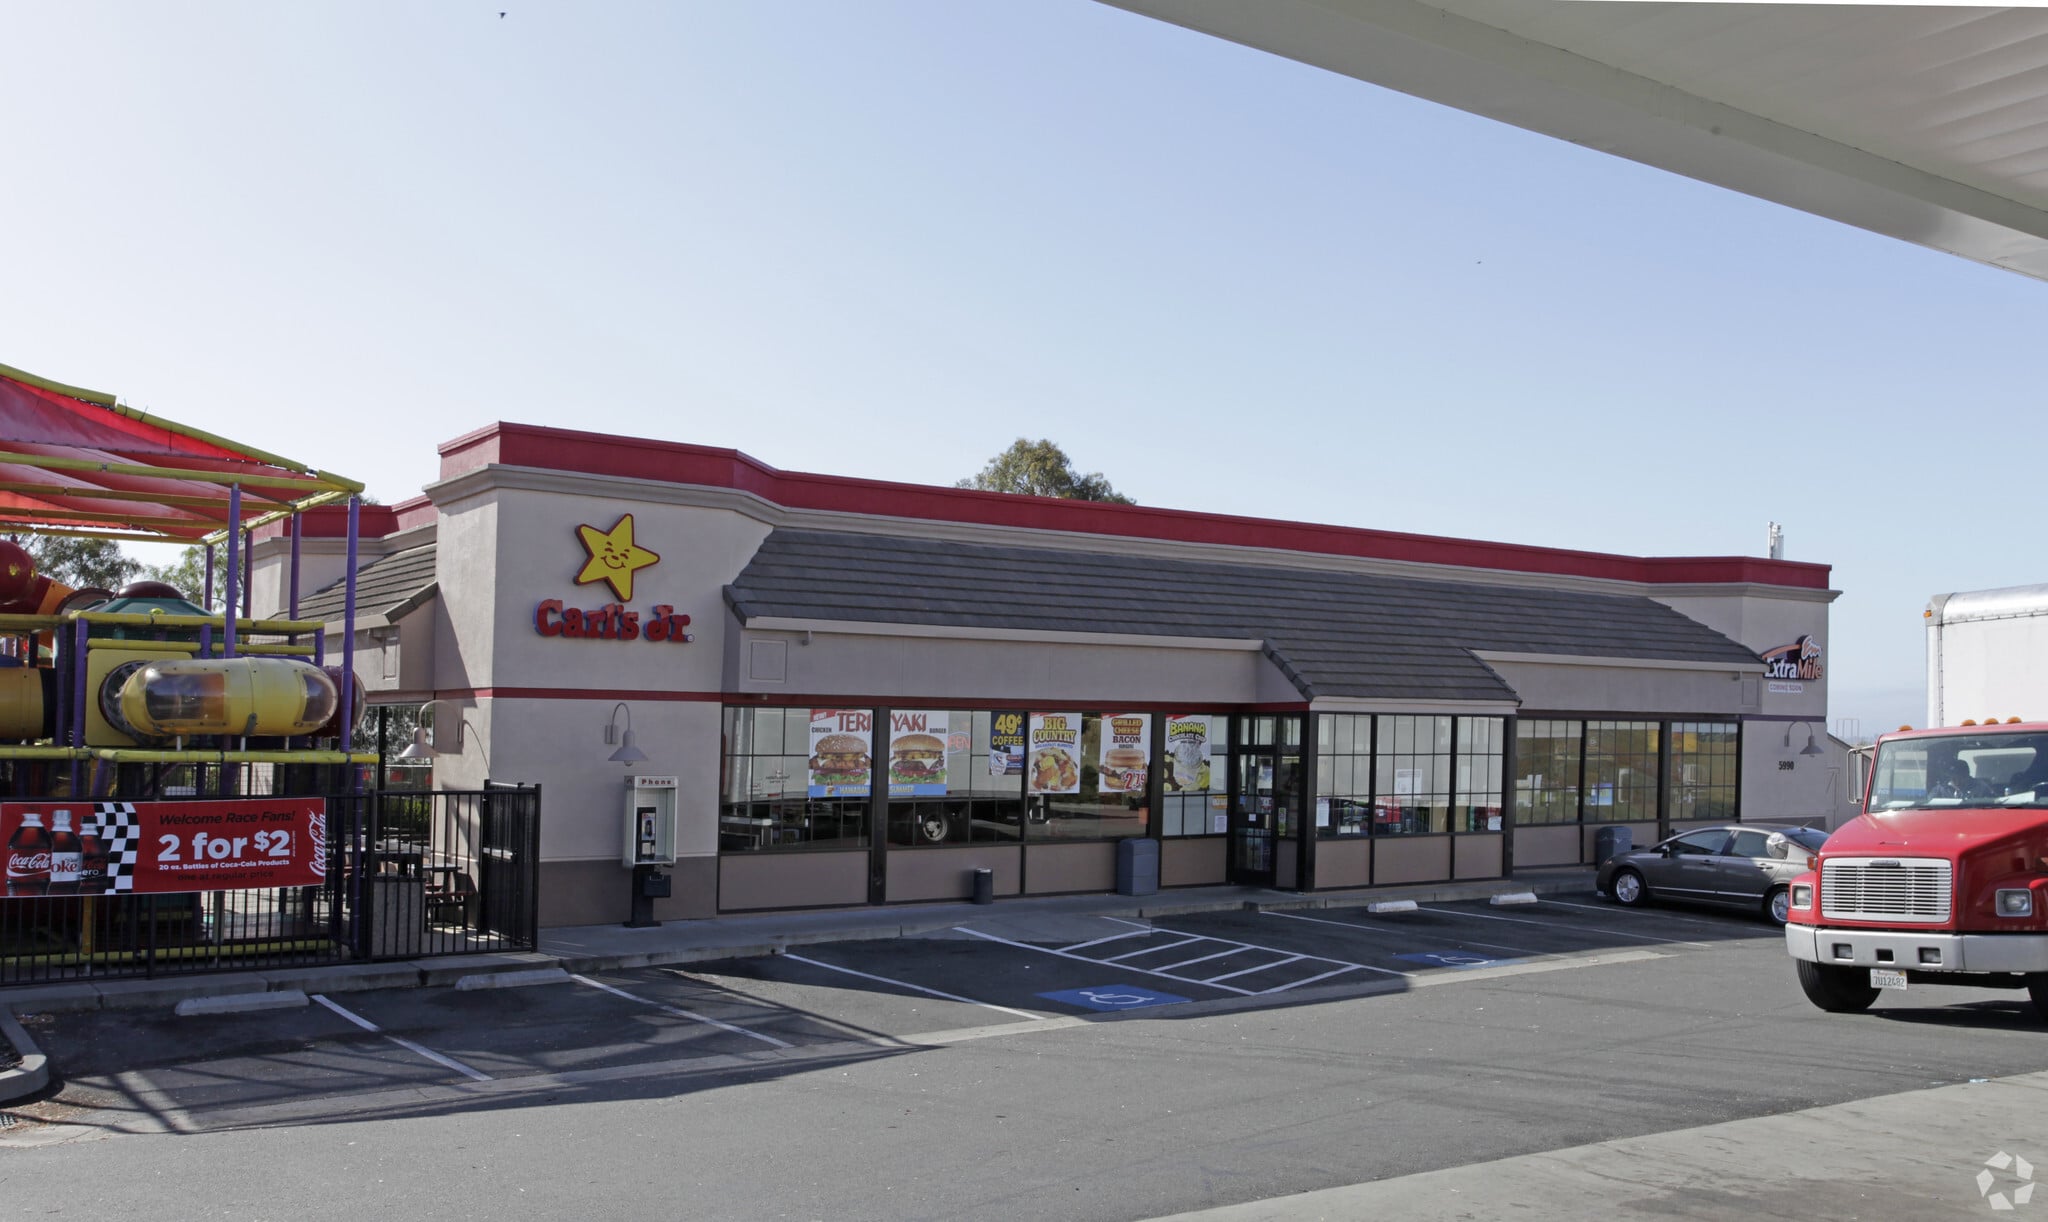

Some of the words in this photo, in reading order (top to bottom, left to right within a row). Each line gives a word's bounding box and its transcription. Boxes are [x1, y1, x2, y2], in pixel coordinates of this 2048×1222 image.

[533, 598, 640, 641] Carl's
[837, 712, 872, 733] TERI
[890, 712, 927, 733] YAKI
[1043, 716, 1067, 730] BIG
[1112, 718, 1143, 727] GRILLED
[1169, 721, 1207, 736] BANANA
[1033, 729, 1077, 744] COUNTRY
[1114, 727, 1141, 735] CHEESE
[946, 735, 972, 750] PEN
[992, 735, 1024, 746] COFFEE
[1112, 735, 1142, 744] BACON
[159, 813, 222, 826] Welcome
[225, 811, 258, 824] Race
[261, 810, 297, 822] Fans!
[157, 834, 181, 862] 2
[191, 831, 248, 860] for
[253, 829, 290, 857] $2
[8, 852, 51, 869] Coca-Cola
[50, 860, 78, 873] oke
[212, 871, 248, 882] regular
[250, 870, 274, 880] price
